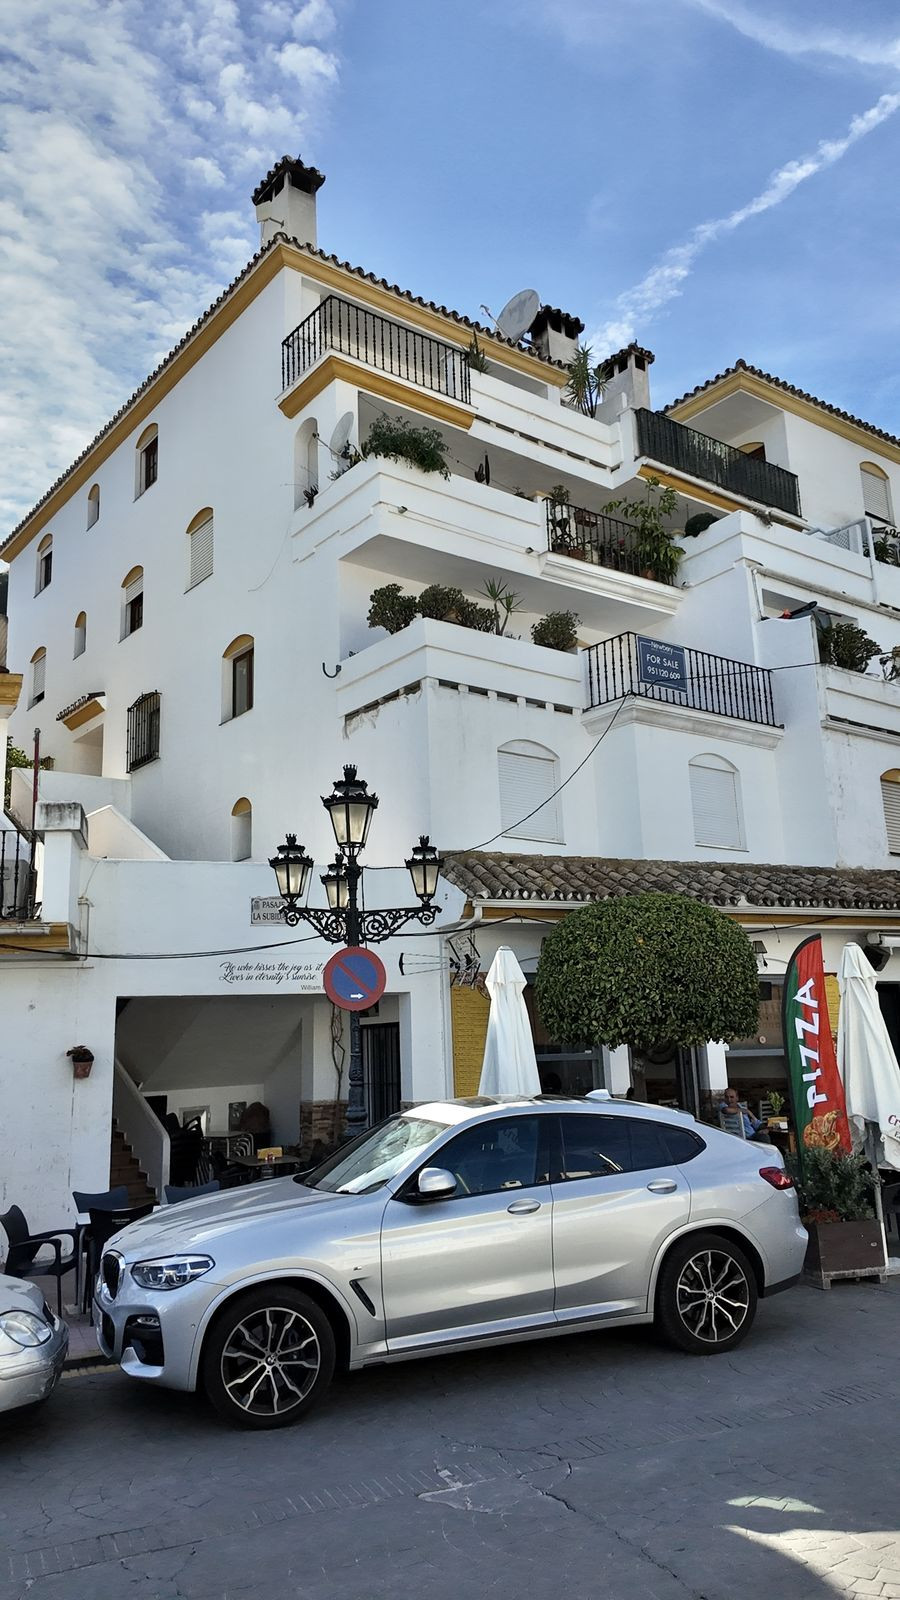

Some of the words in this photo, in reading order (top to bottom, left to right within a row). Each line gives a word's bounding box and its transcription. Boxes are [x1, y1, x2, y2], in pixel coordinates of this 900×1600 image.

[646, 654, 661, 665] FOR
[662, 658, 679, 669] SALE
[669, 671, 680, 680] 609
[252, 912, 261, 920] LA
[220, 962, 236, 972] He
[237, 962, 253, 971] who
[254, 963, 276, 971] kisses
[277, 963, 290, 971] the
[220, 970, 244, 984] Lives
[246, 971, 254, 981] in
[255, 972, 289, 985] eternity's
[793, 978, 828, 1108] PIZZA
